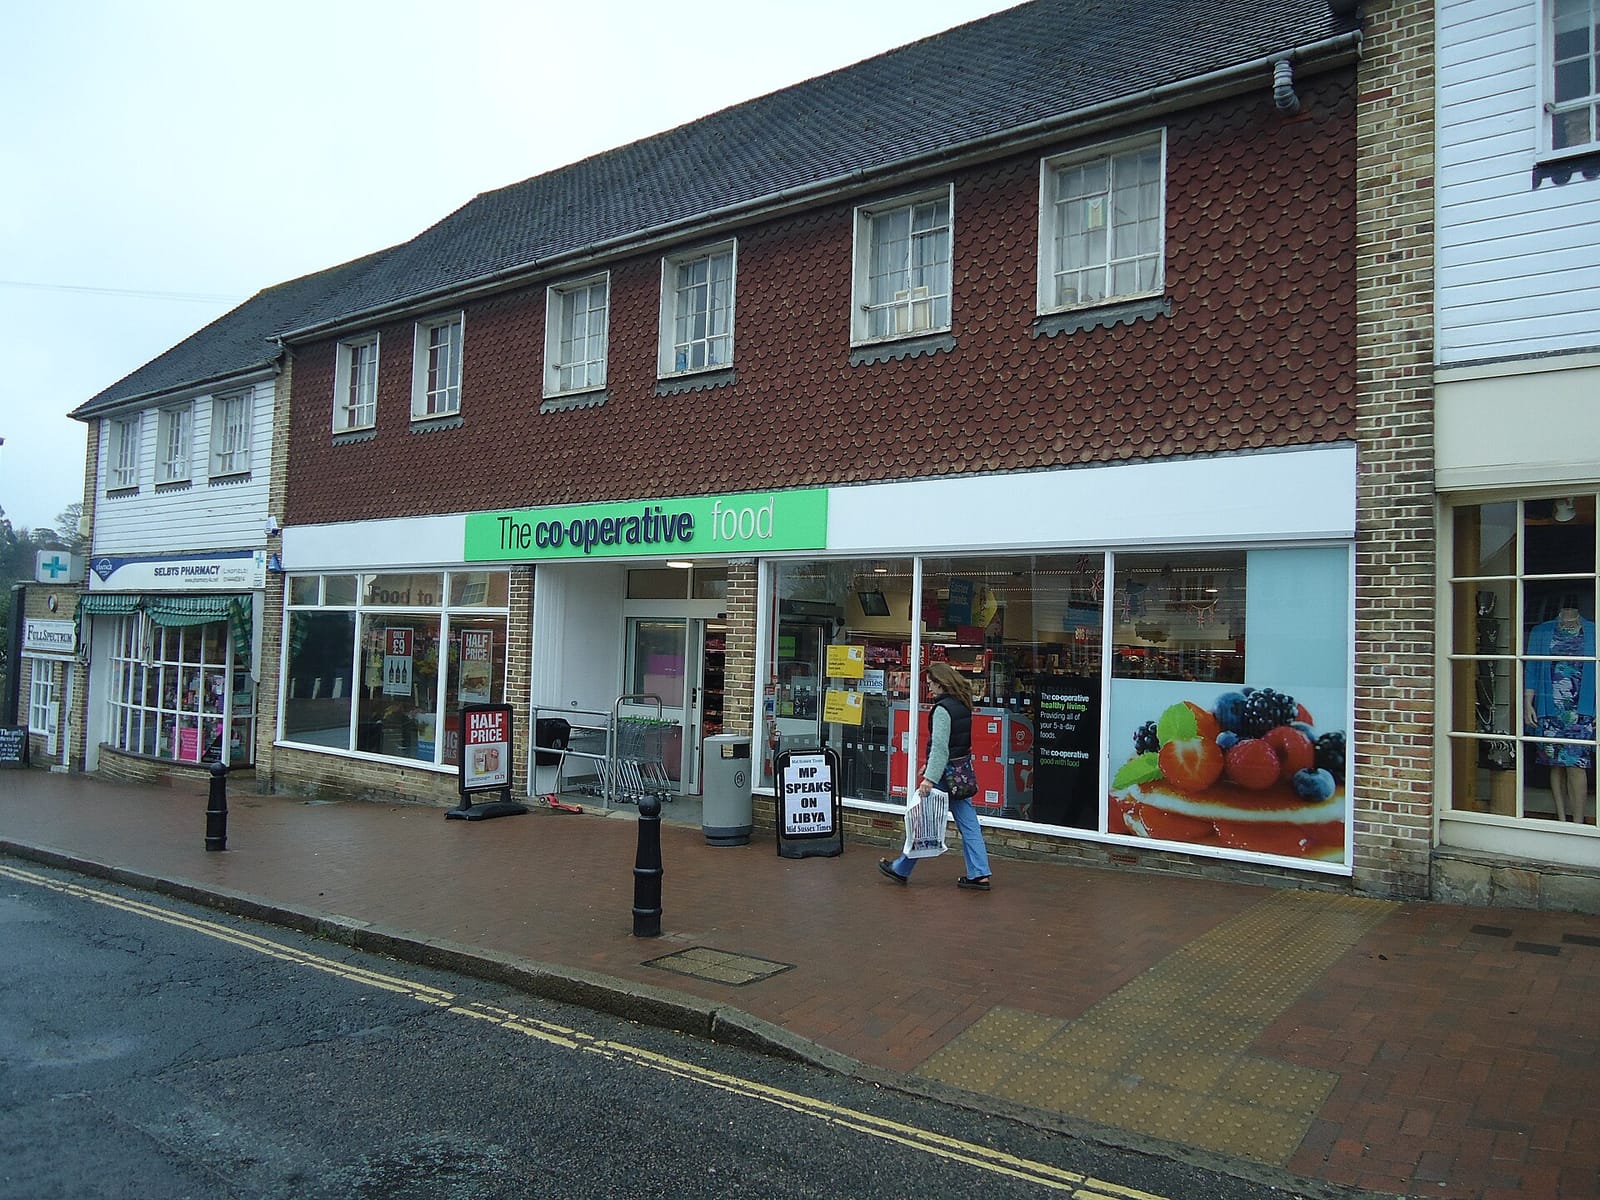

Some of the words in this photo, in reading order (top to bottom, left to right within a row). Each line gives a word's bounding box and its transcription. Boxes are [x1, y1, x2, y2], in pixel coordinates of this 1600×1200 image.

[498, 516, 531, 549] The
[535, 506, 695, 553] co-operative
[711, 496, 774, 540] food
[181, 565, 220, 576] PHARMACY
[370, 585, 411, 606] Food
[417, 590, 433, 605] to
[466, 633, 488, 648] HALF
[393, 639, 405, 655] £9
[465, 647, 488, 661] PRICE
[1041, 692, 1052, 700] The
[1052, 694, 1089, 702] co-operative
[1041, 701, 1065, 711] healthy
[470, 713, 503, 729] HALF
[1040, 711, 1065, 721] Providing
[1040, 722, 1052, 730] your
[1053, 722, 1076, 732] 5-a-day
[470, 729, 503, 743] PRICE
[1040, 747, 1051, 756] The
[1051, 750, 1089, 759] co-operative
[1040, 758, 1054, 766] good
[798, 767, 817, 778] MP
[786, 781, 832, 794] SPEAKS
[801, 798, 817, 808] ON
[792, 812, 826, 824] LIBYA
[816, 823, 832, 831] Times
